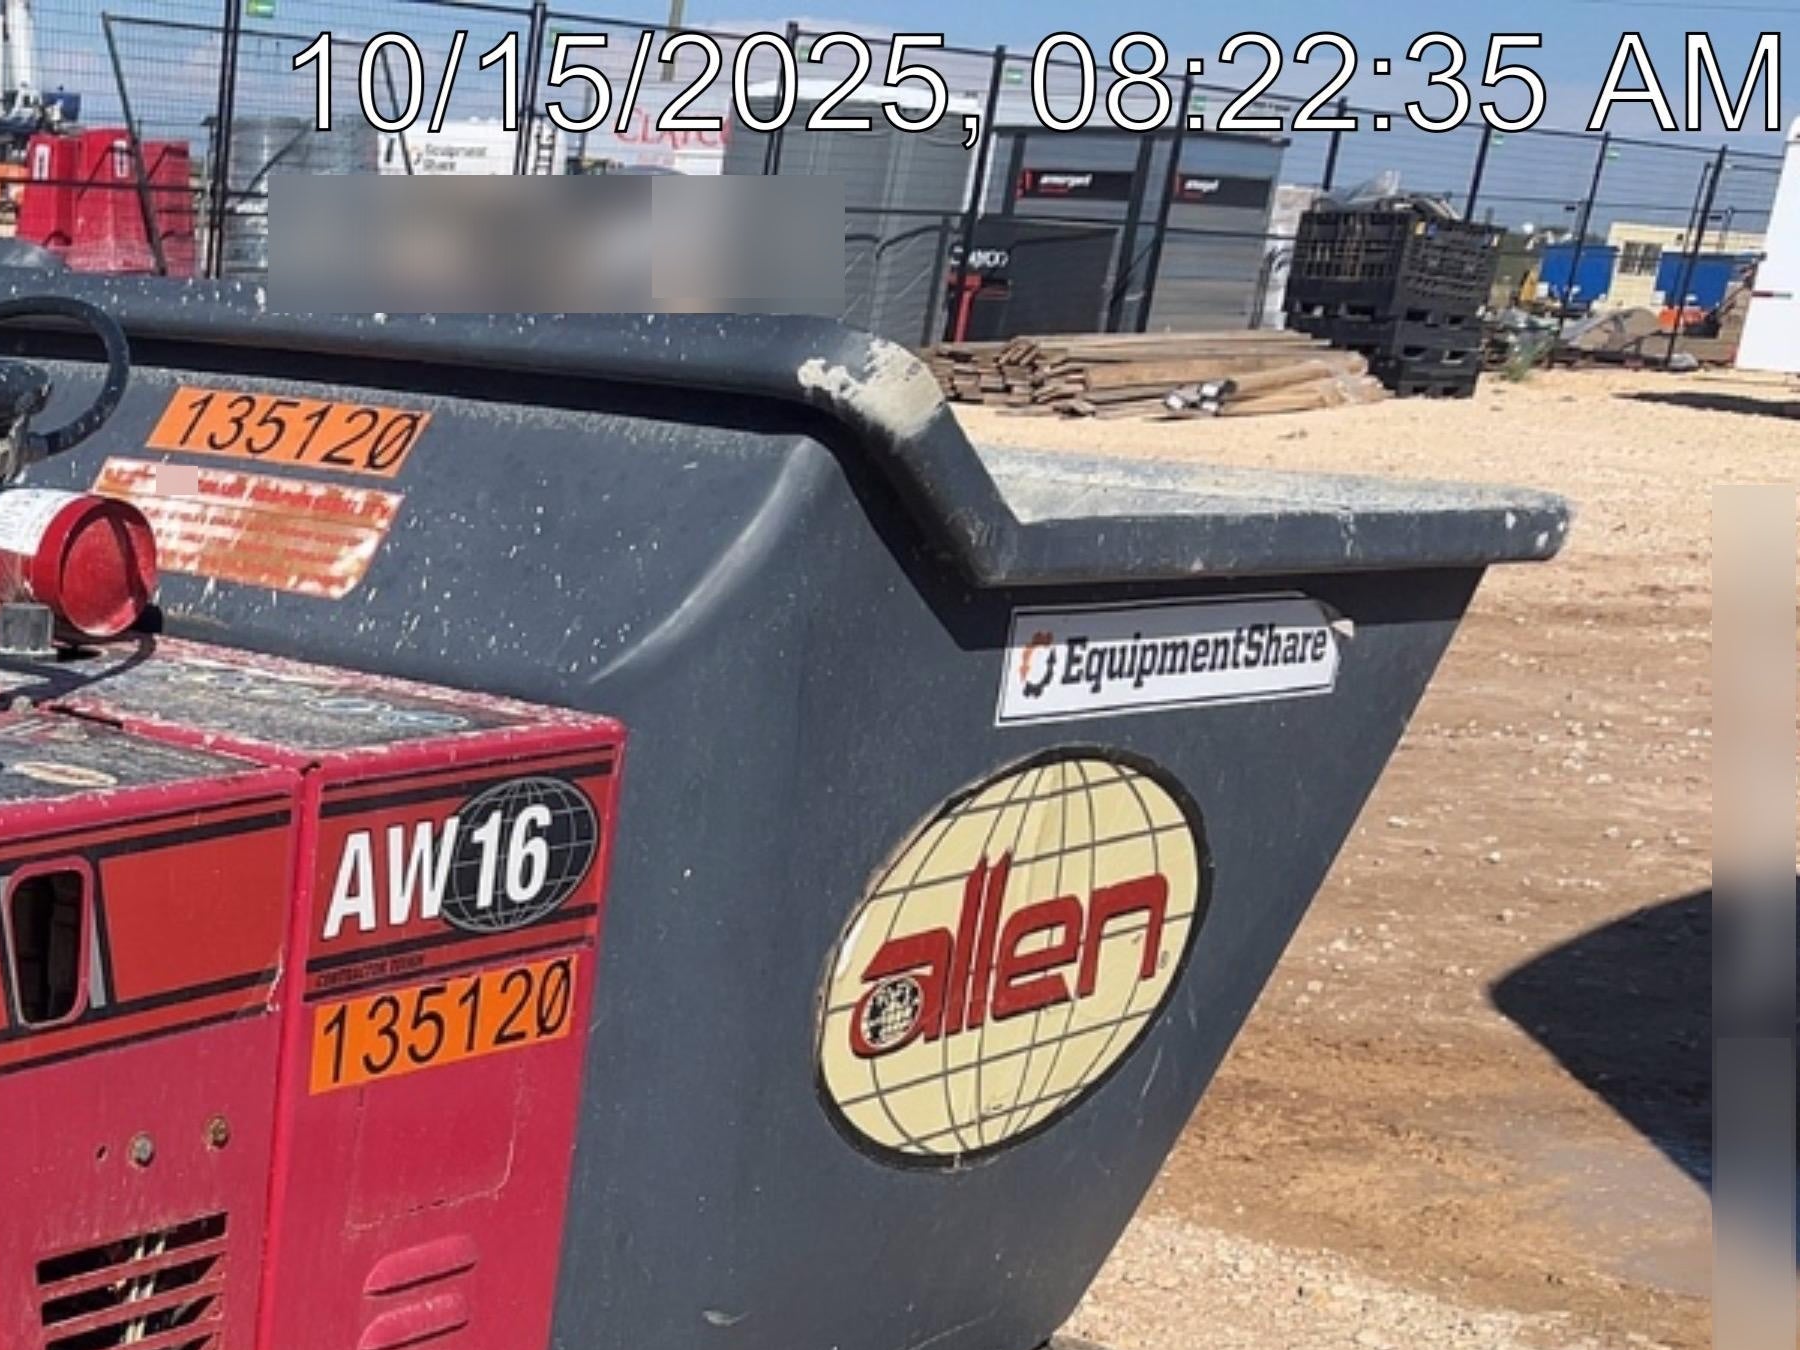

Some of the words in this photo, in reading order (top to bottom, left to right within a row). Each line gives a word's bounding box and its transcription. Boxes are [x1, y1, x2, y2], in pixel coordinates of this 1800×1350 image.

[178, 392, 422, 469] 135120
[1061, 624, 1327, 694] EquipmentShare
[848, 848, 1169, 1060] allen
[323, 957, 572, 1083] 135120
